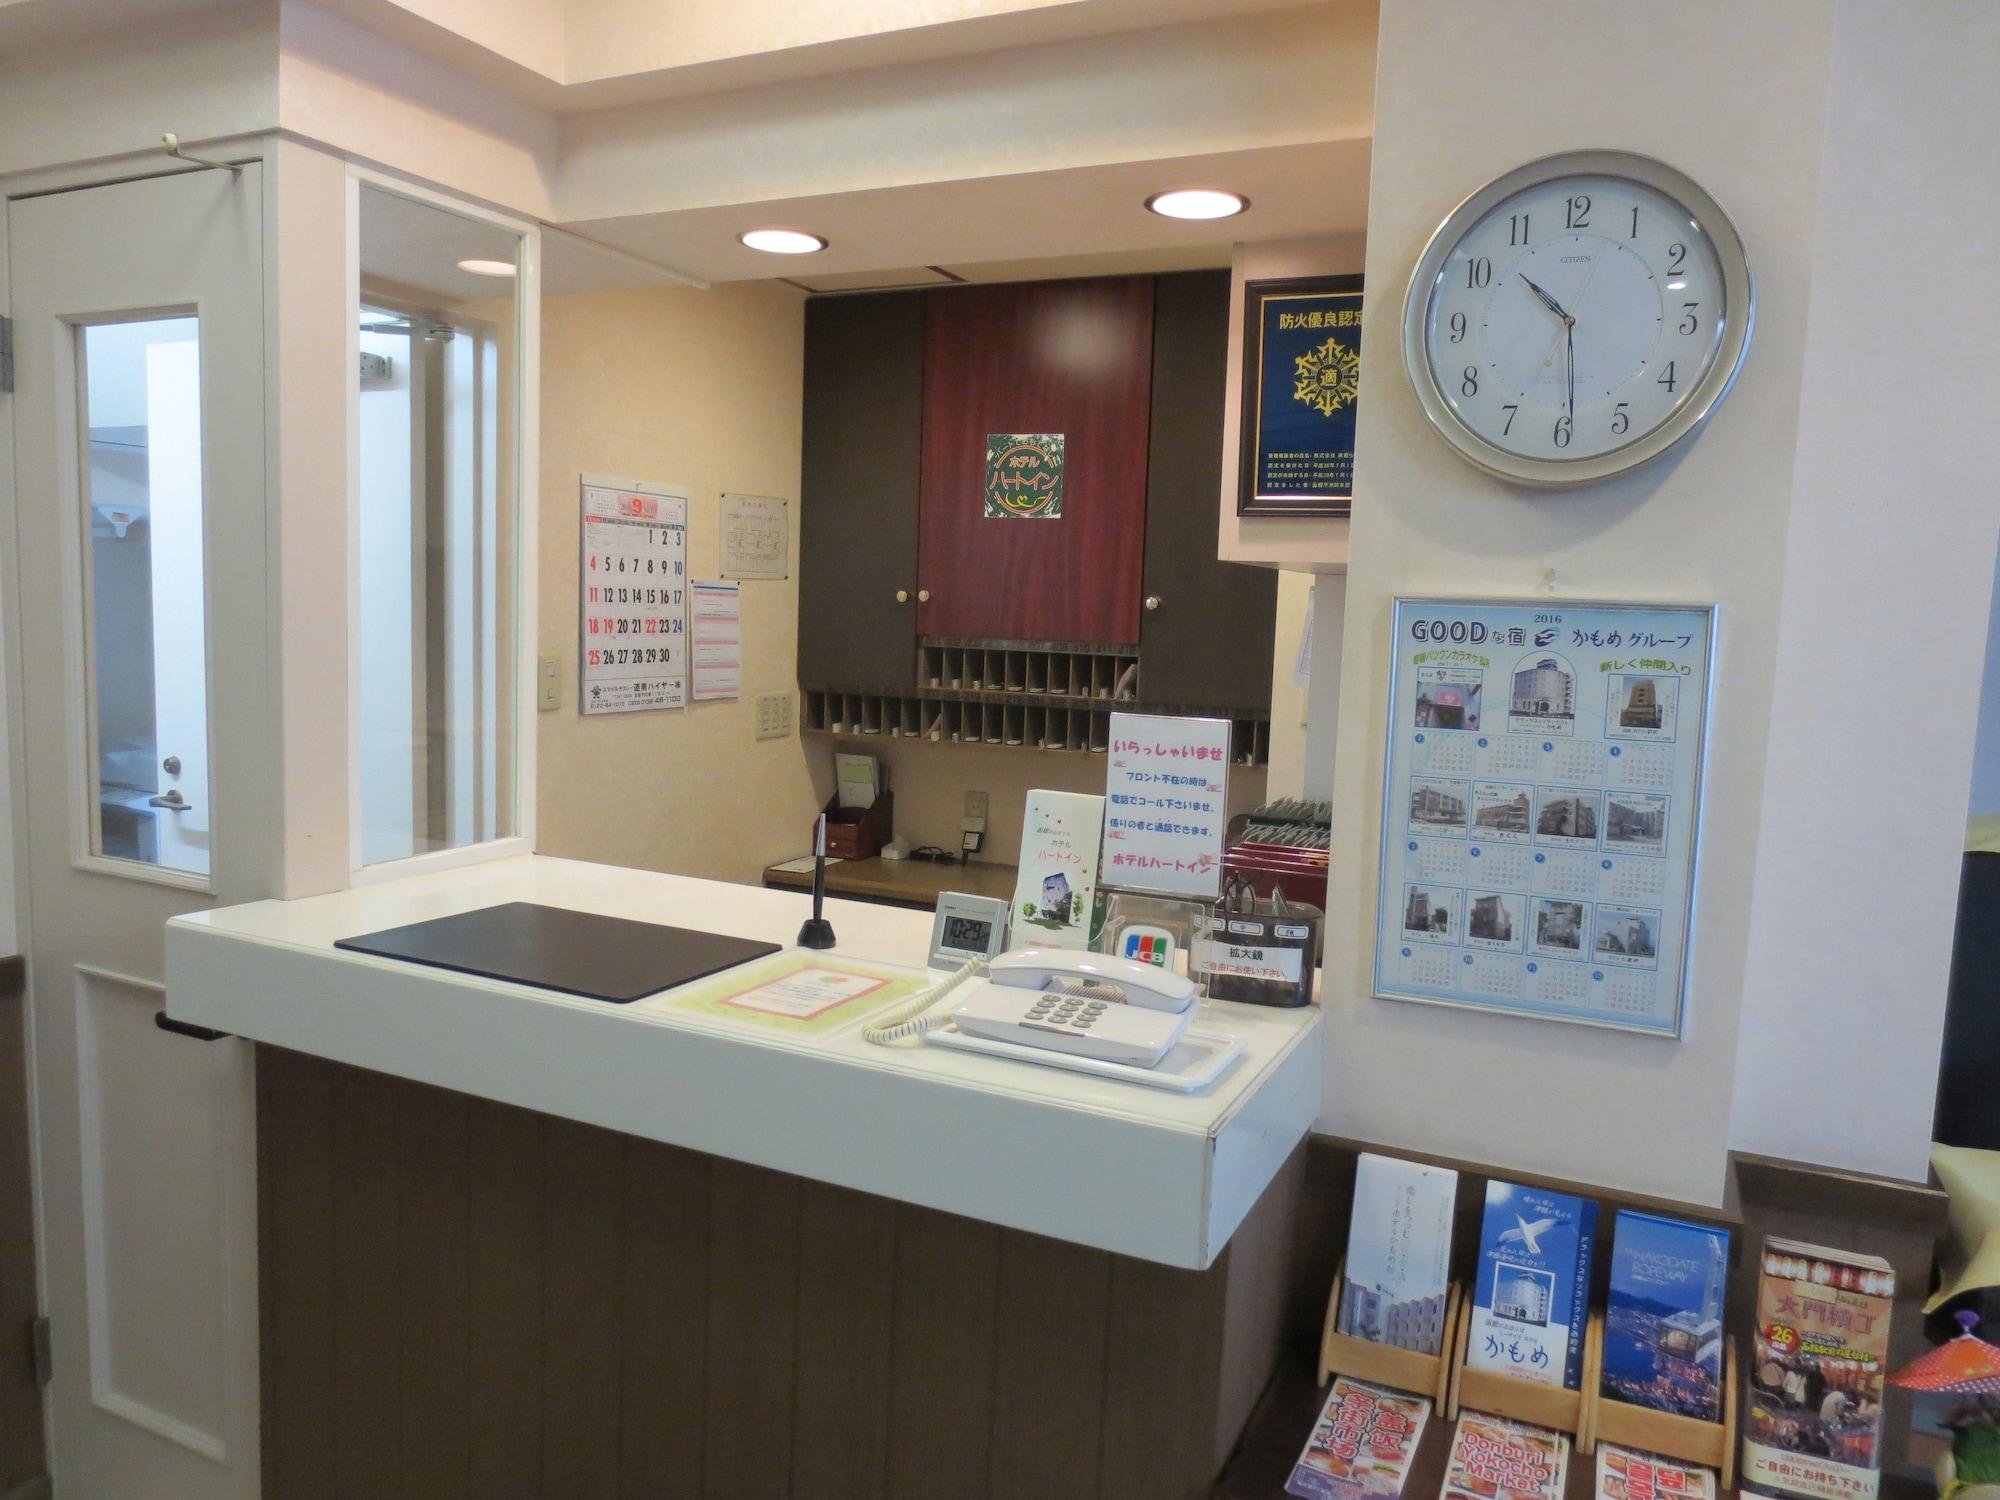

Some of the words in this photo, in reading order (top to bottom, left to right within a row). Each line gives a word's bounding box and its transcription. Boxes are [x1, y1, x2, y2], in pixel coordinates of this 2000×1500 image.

[1565, 196, 1591, 229] 12
[1631, 207, 1638, 238] 1
[1509, 214, 1529, 246] 11
[1560, 255, 1591, 264] CITIZEN
[1667, 244, 1687, 276] 2
[1467, 256, 1491, 289] 10
[1450, 312, 1466, 343] 9
[1679, 302, 1699, 335] 3
[1320, 367, 1337, 388] 適
[1461, 366, 1478, 397] 8
[1658, 361, 1676, 393] 4
[1502, 405, 1518, 436] 7
[1612, 403, 1629, 434] 5
[1554, 416, 1571, 448] 6
[1009, 456, 1040, 468] ホテル
[990, 471, 1059, 490] ハートイン
[632, 499, 642, 514] 9
[649, 529, 653, 544] 1
[662, 531, 667, 545] 2
[676, 532, 681, 546] 3
[590, 556, 596, 571] 4
[605, 556, 611, 572] 5
[619, 557, 625, 572] 6
[633, 558, 639, 573] 7
[647, 559, 653, 574] 8
[662, 560, 667, 575] 9
[674, 560, 683, 575] 10
[589, 587, 598, 602] 11
[604, 588, 613, 603] 12
[618, 588, 627, 603] 13
[632, 589, 642, 603] 14
[646, 589, 655, 604] 15
[660, 590, 669, 604] 16
[674, 590, 682, 605] 17
[589, 619, 599, 634] 18
[603, 619, 613, 634] 19
[617, 619, 628, 634] 20
[632, 619, 641, 633] 21
[645, 619, 656, 633] 22
[659, 619, 670, 633] 23
[672, 619, 683, 633] 24
[1534, 614, 1562, 624] 2016
[589, 650, 600, 665] 25
[603, 650, 614, 665] 26
[618, 650, 628, 664] 27
[632, 649, 643, 664] 28
[646, 649, 656, 663] 29
[659, 648, 670, 662] 30
[1600, 658, 1691, 676] 新しく仲間入り
[1113, 740, 1223, 762] いらっしゃいませ
[1126, 771, 1208, 788] フロント不在の時は
[1051, 839, 1072, 849] ホテル
[1039, 850, 1082, 864] ハートイン
[1113, 853, 1213, 875] ホテルハートイン
[1125, 950, 1164, 964] JCB
[1229, 948, 1264, 961] 拡大鏡
[1771, 1325, 1792, 1344] 26
[1485, 1334, 1549, 1369] かもめ
[1464, 1431, 1546, 1465] Donburi
[1461, 1443, 1547, 1479] Yokocho
[1465, 1460, 1540, 1493] Market
[1756, 1458, 1874, 1493] ご自由にお持ち下さい
